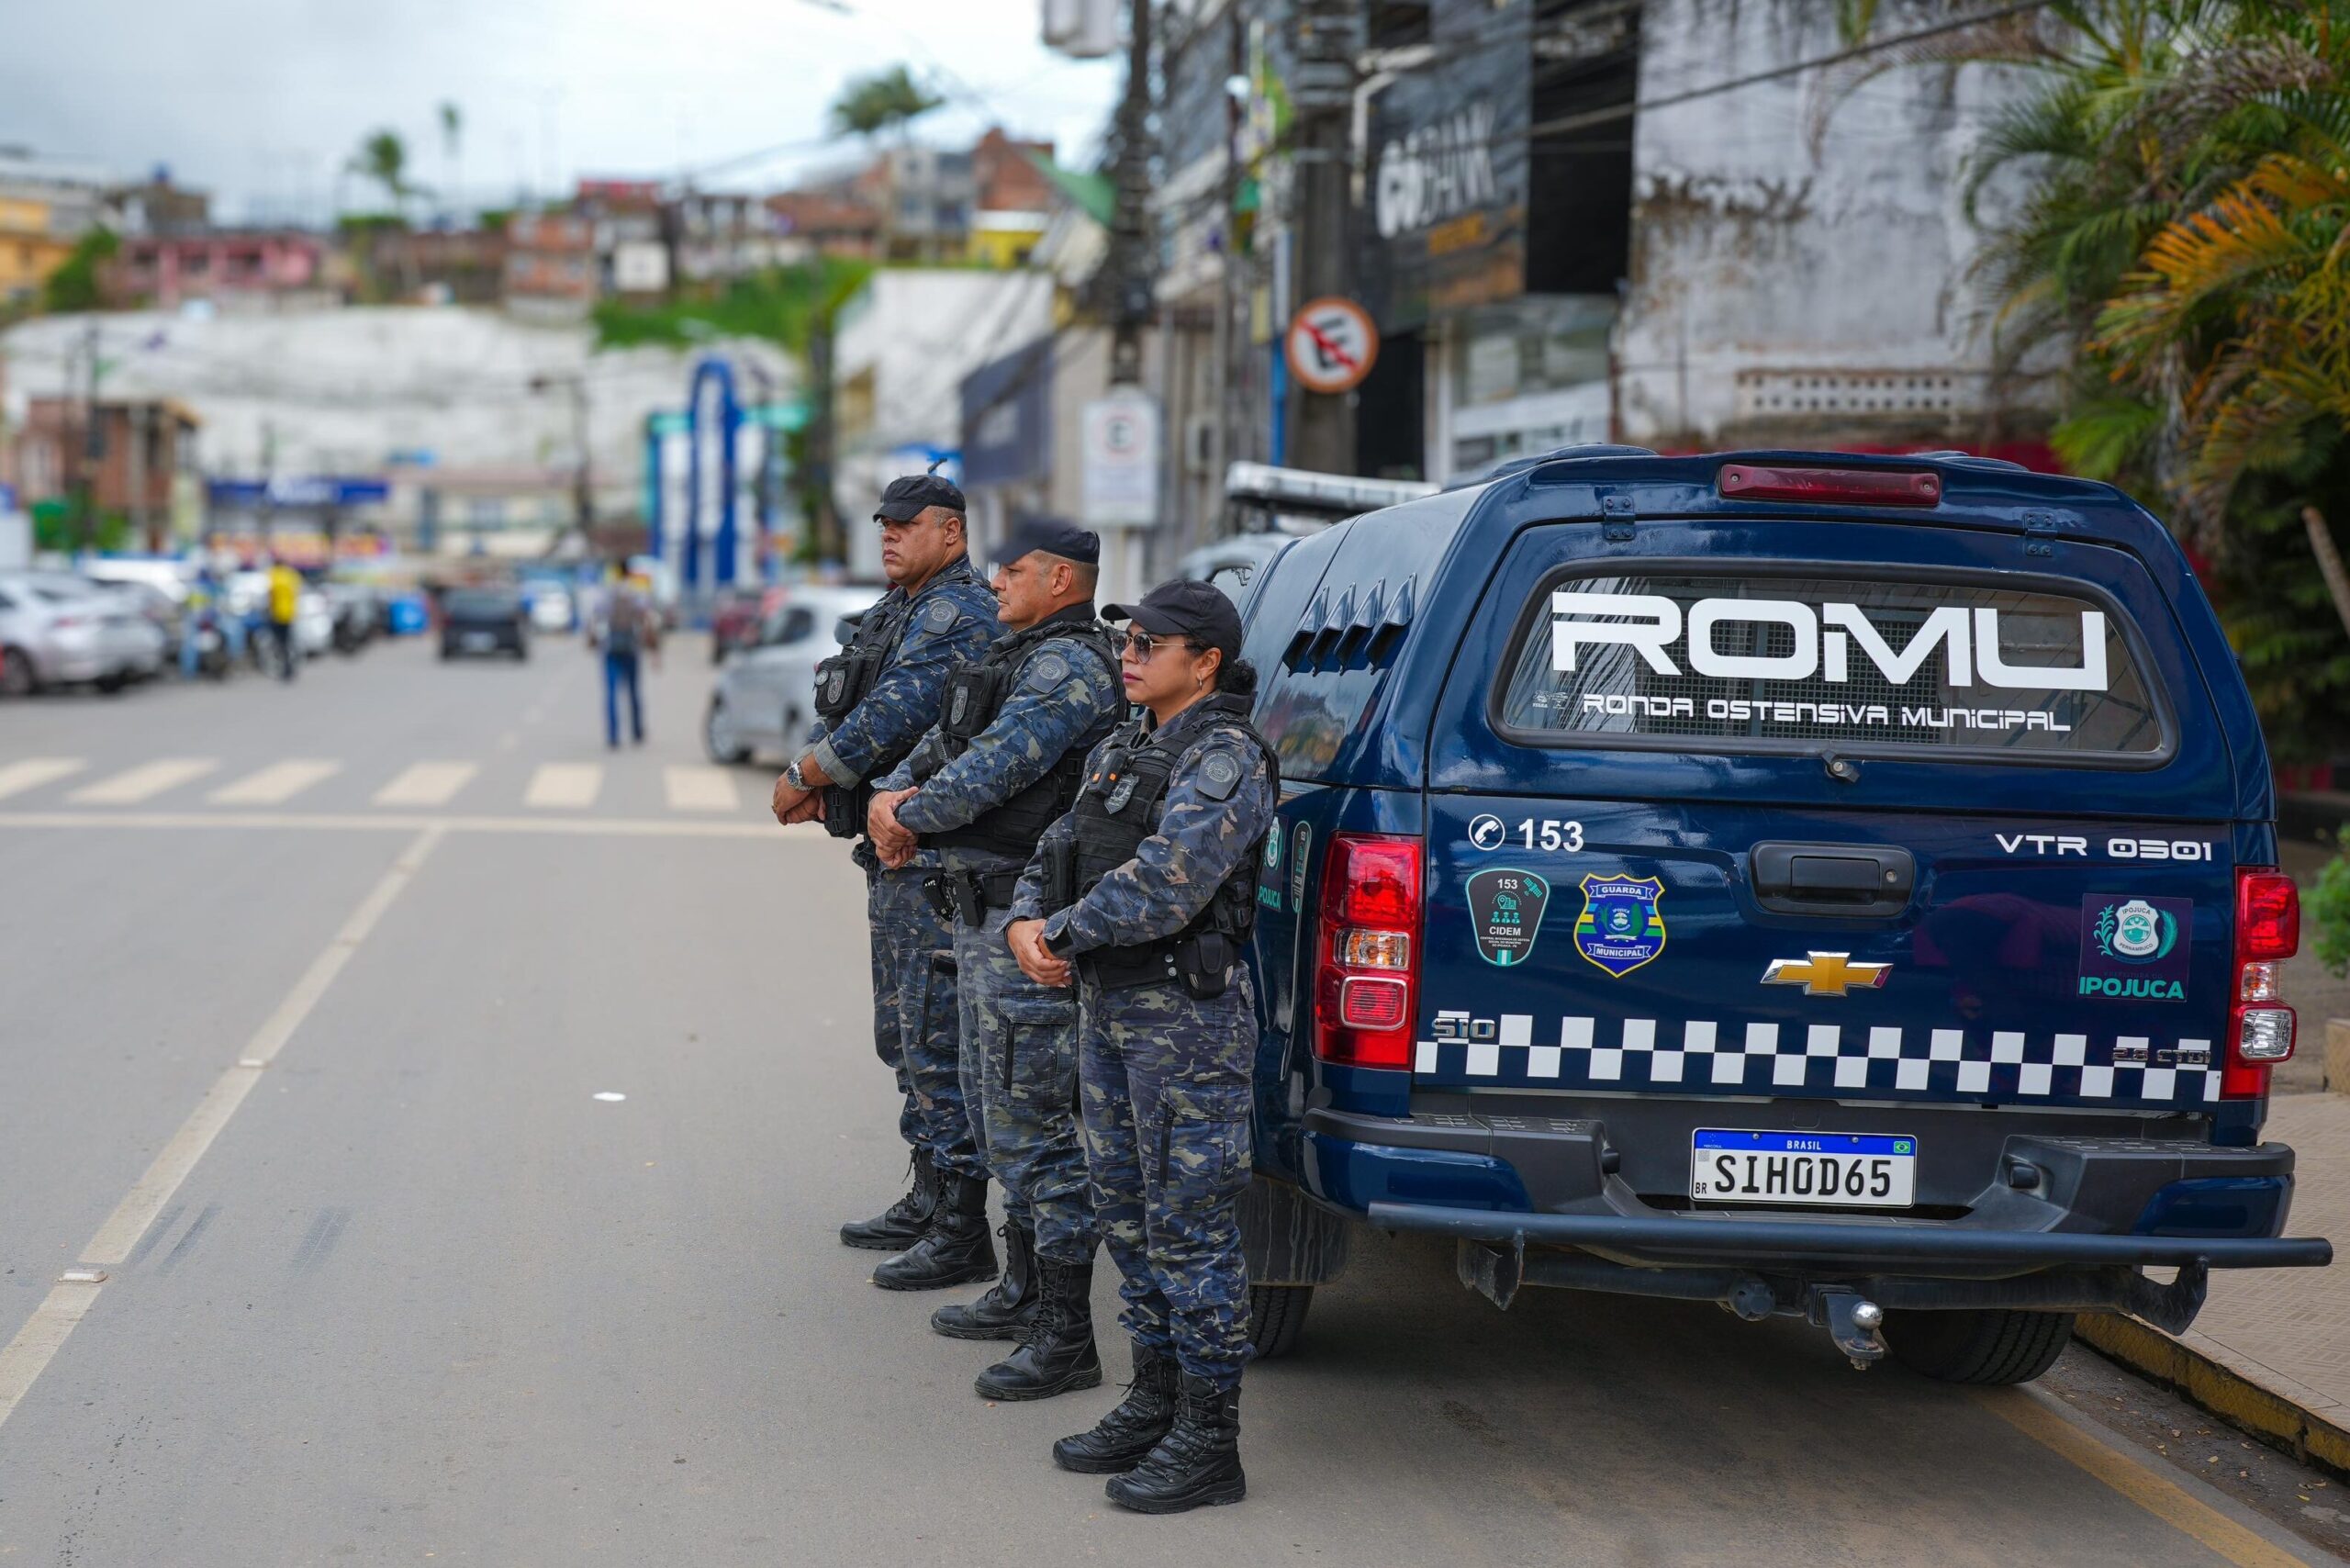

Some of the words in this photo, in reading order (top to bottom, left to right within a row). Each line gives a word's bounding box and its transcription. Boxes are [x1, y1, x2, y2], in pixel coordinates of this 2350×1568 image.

[1552, 591, 2108, 690] ROMU
[1583, 693, 1694, 717] RONDA
[1518, 818, 1583, 852] 153
[1995, 834, 2087, 856] VTR
[1497, 879, 1518, 890] 153
[1601, 885, 1642, 896] GUARDA
[1489, 926, 1521, 935] CIDEM
[1595, 946, 1642, 958] MUNICIPAL
[2078, 976, 2184, 999] IPOJUCA
[1432, 1017, 1495, 1038] S10
[1786, 1139, 1821, 1150] BRASIL
[1695, 1182, 1707, 1194] BR
